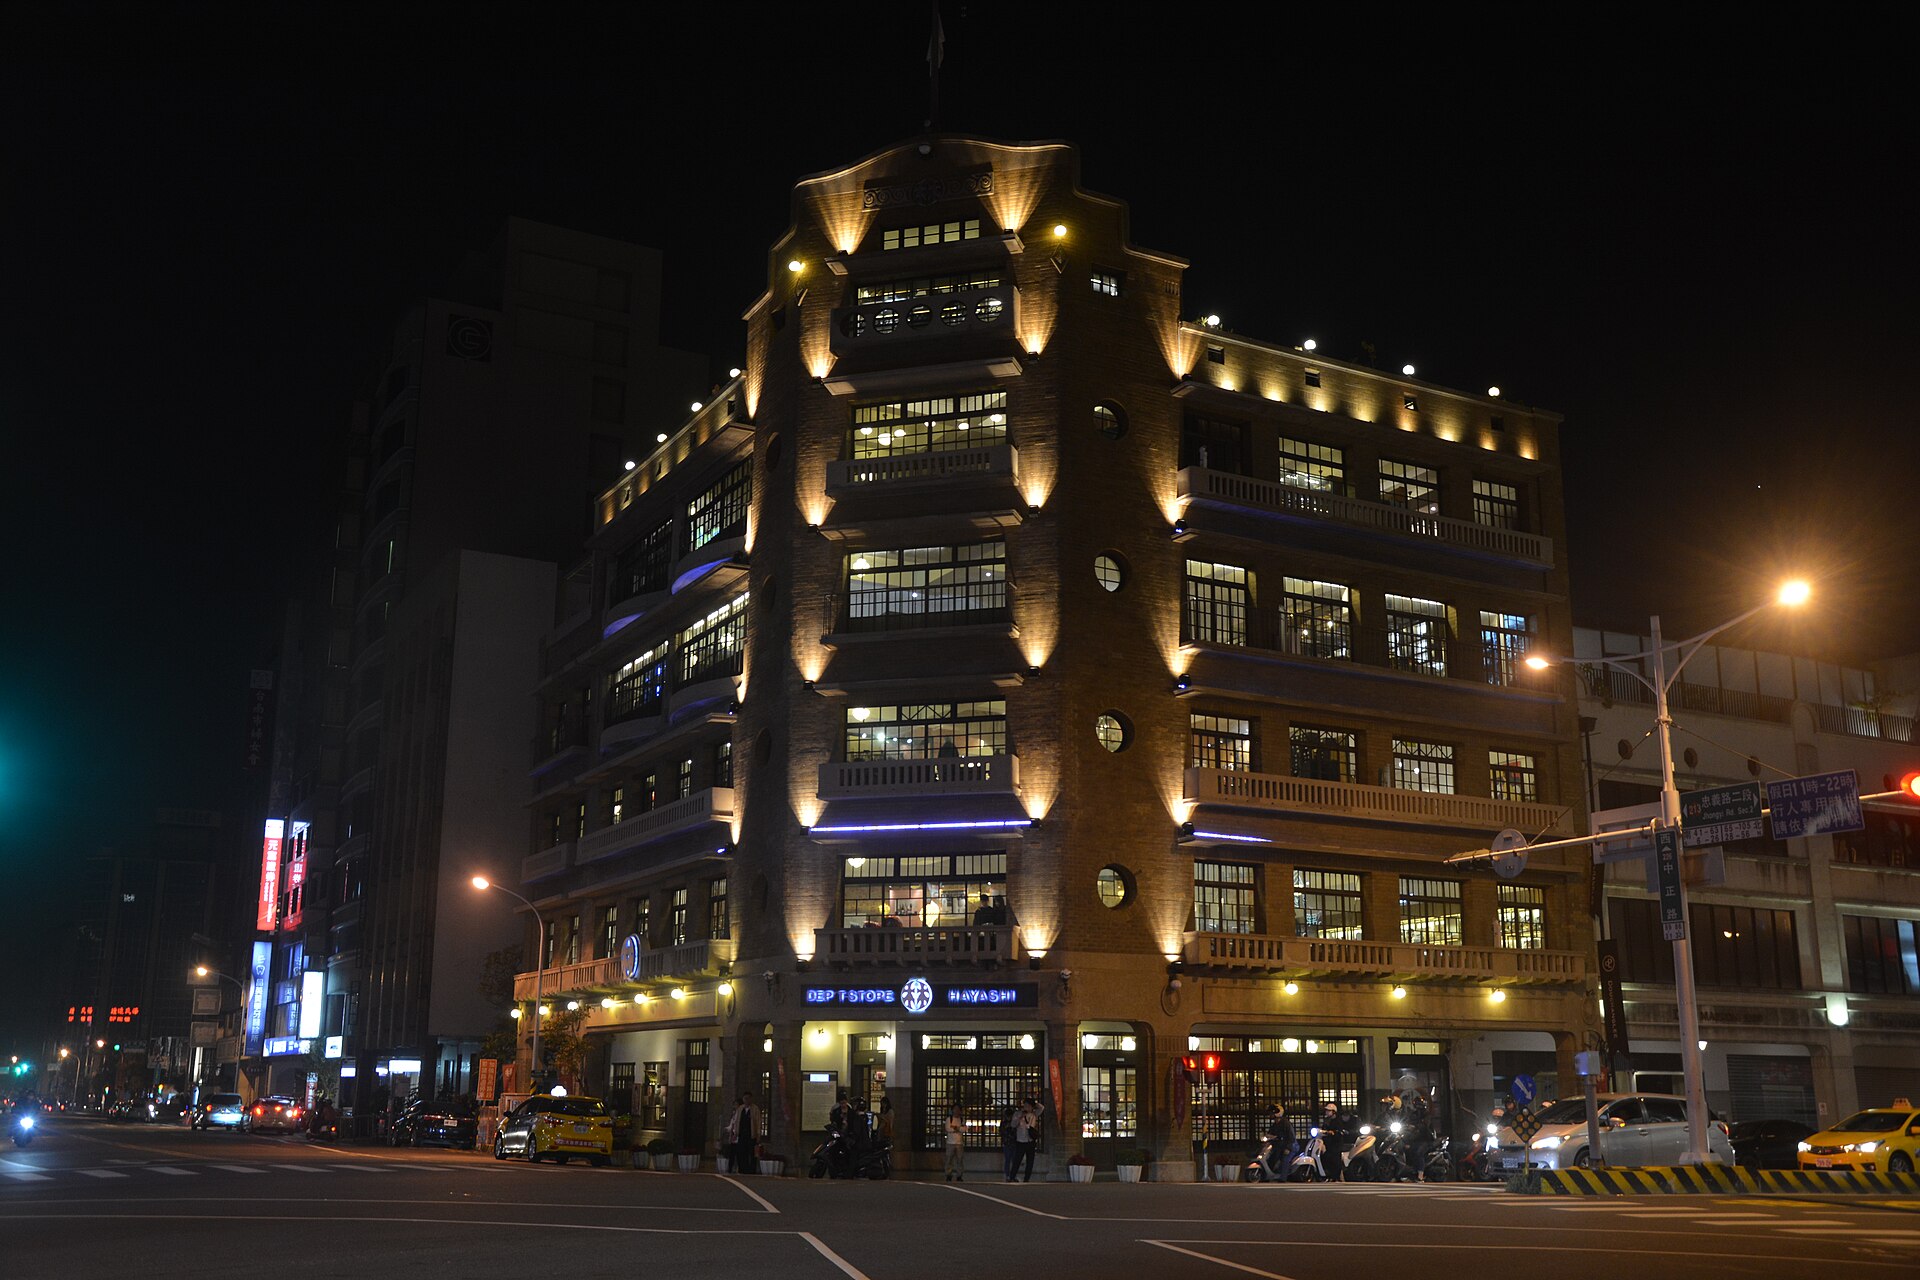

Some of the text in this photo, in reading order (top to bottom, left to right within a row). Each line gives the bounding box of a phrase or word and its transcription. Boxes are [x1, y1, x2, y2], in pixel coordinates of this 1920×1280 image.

[1701, 788, 1752, 808] 忠義路二段
[948, 989, 1016, 1002] HAYASHI
